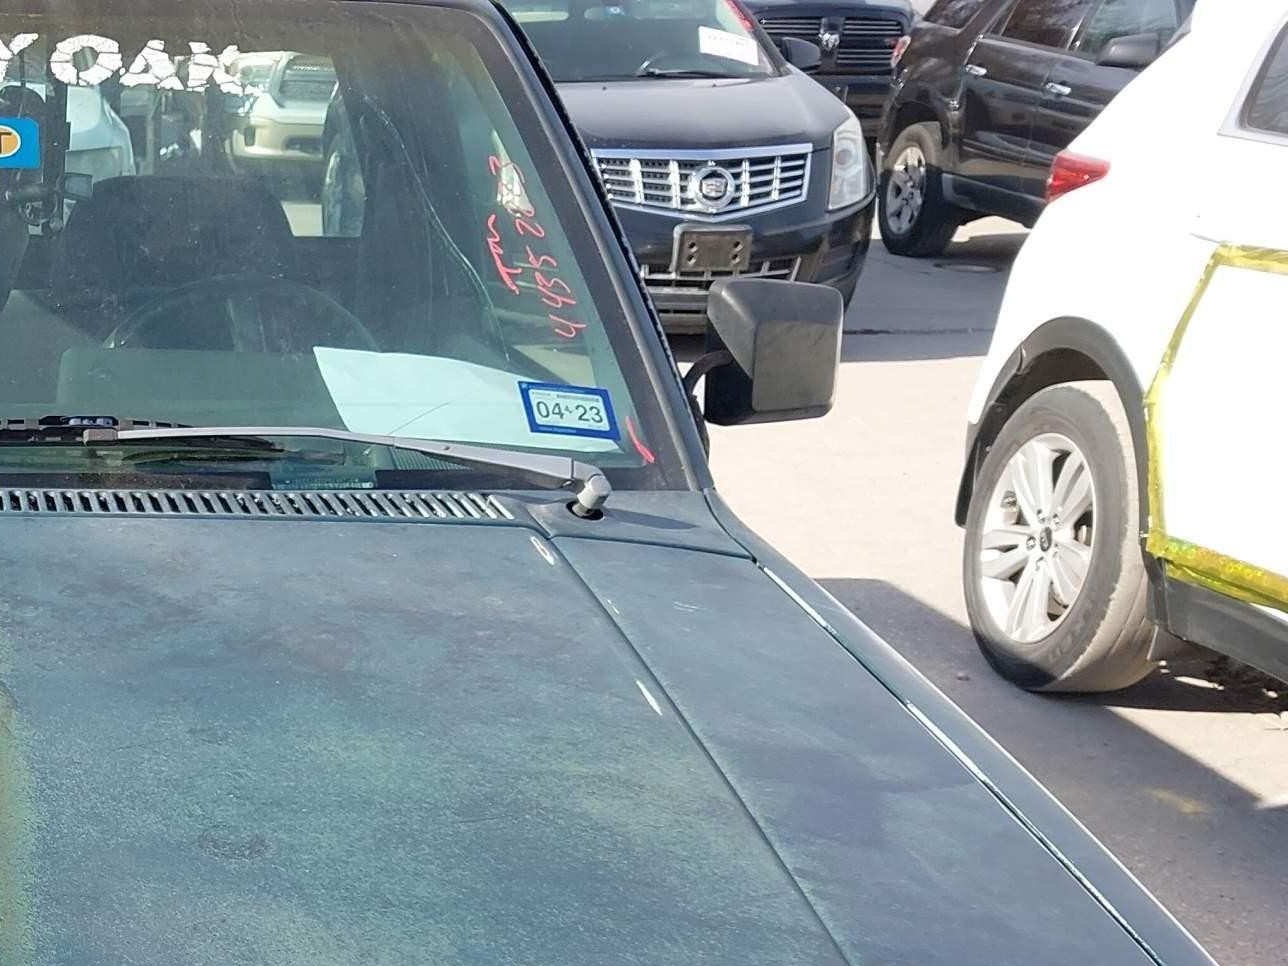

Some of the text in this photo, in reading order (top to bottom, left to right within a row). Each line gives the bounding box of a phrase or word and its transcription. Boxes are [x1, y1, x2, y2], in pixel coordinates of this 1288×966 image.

[49, 34, 264, 97] OAK
[535, 400, 604, 424] 04 23
